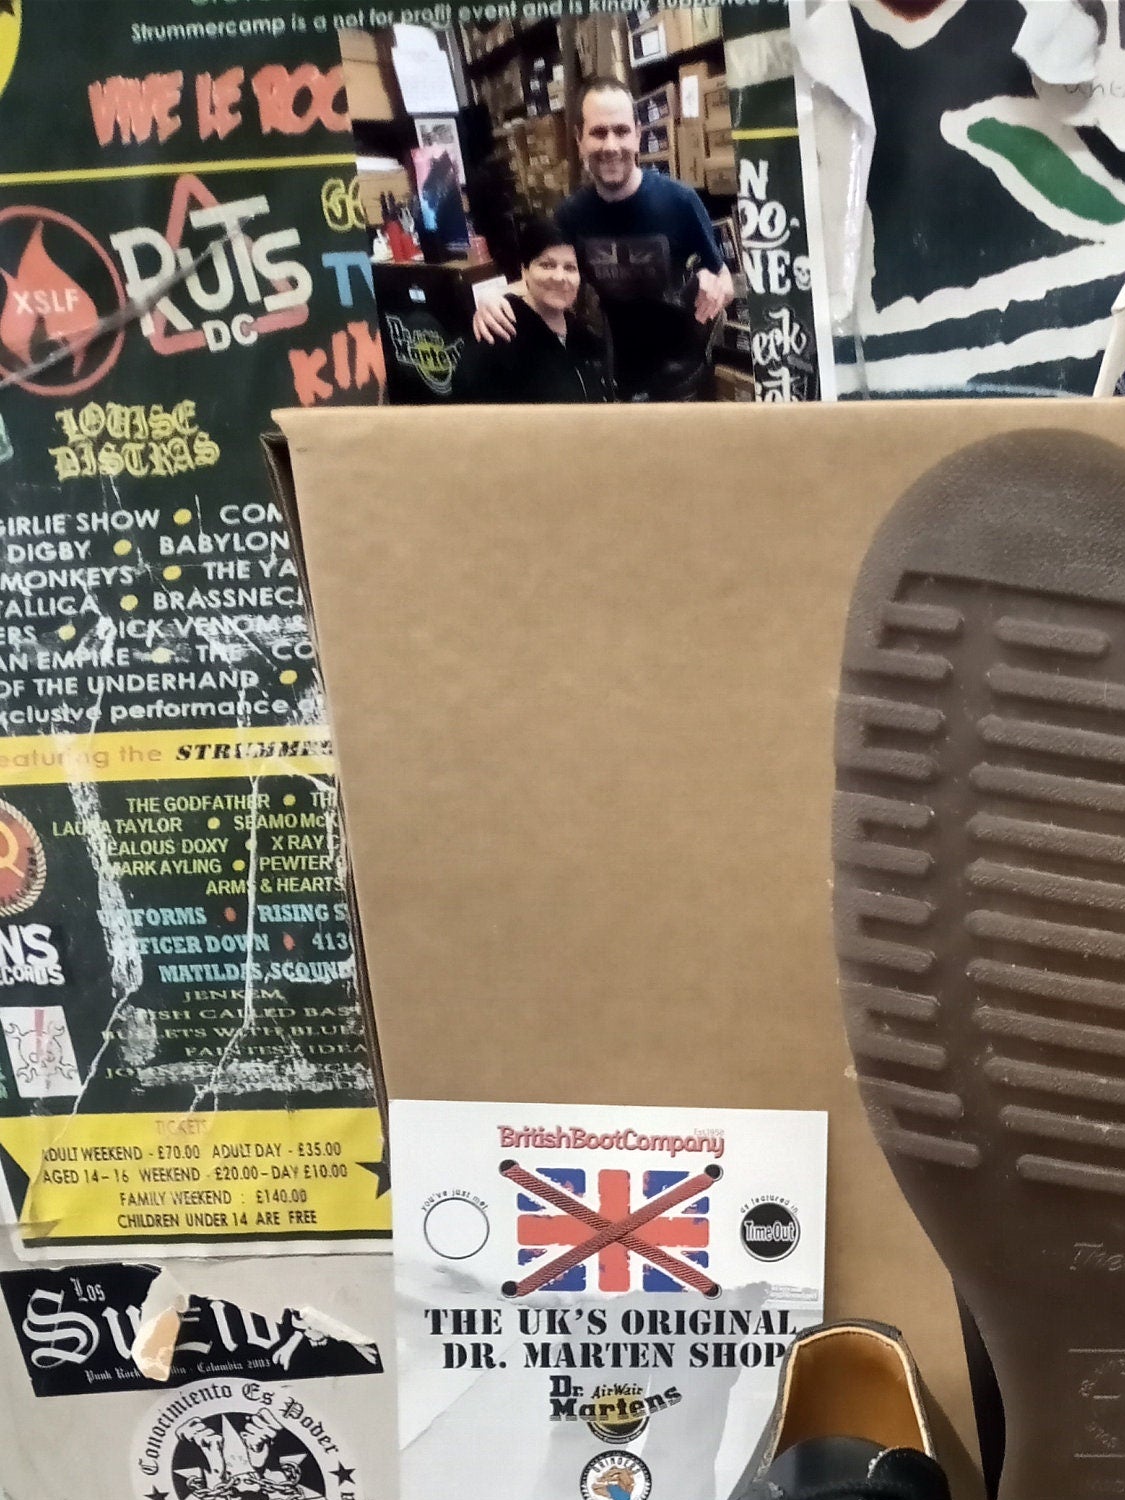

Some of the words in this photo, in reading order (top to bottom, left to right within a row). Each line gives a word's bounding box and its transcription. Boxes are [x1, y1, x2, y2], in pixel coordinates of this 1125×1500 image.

[131, 15, 285, 44] Strummercamp
[110, 195, 313, 337] RUTS
[0, 513, 67, 538] IRLIE
[76, 509, 161, 533] SHOW
[7, 540, 91, 563] DIGBY
[160, 531, 290, 555] BABYLON
[1, 565, 134, 592] MONKEYS
[203, 559, 250, 580] THE
[0, 595, 100, 618] ALLICA
[153, 586, 304, 610] BRASSNEC
[33, 677, 78, 697] THE
[88, 670, 259, 695] UNDERHAND
[111, 699, 290, 724] performance
[126, 797, 161, 813] THE
[164, 794, 270, 812] GODFATHER
[52, 819, 112, 837] LAUA
[115, 817, 183, 835] TAYLOR
[103, 838, 176, 856] EALOUS
[182, 838, 229, 854] DOXY
[288, 834, 325, 850] RAY
[160, 858, 223, 875] AYLING
[259, 855, 332, 871] PEWTER
[257, 904, 330, 922] RISING
[81, 1146, 143, 1161] WEEKEND
[158, 1144, 200, 1160] £70.00
[212, 1143, 250, 1158] ADULT
[255, 1143, 282, 1157] DAY
[298, 1141, 342, 1156] £35.00
[497, 1124, 725, 1158] BritishBootCompany
[43, 1169, 79, 1184] AGED
[139, 1167, 200, 1182] WEEKEND
[304, 1163, 348, 1178] £10.00
[120, 1191, 166, 1207] FAMILY
[172, 1189, 232, 1205] WEEKEND
[117, 1213, 179, 1228] CHILDREN
[185, 1212, 228, 1227] UNDER
[232, 1212, 248, 1226] 14
[256, 1211, 280, 1225] ARE
[288, 1209, 317, 1224] FREE
[424, 1309, 504, 1335] THE
[518, 1308, 608, 1336] UK'S
[621, 1308, 799, 1336] ORIGINAL
[442, 1342, 506, 1369] DR.
[524, 1341, 674, 1369] MARTEN
[688, 1341, 786, 1369] SHOP
[549, 1375, 585, 1397] Dr.
[549, 1385, 684, 1421] Martens
[242, 1383, 276, 1406] Es
[278, 1397, 340, 1454] Poder
